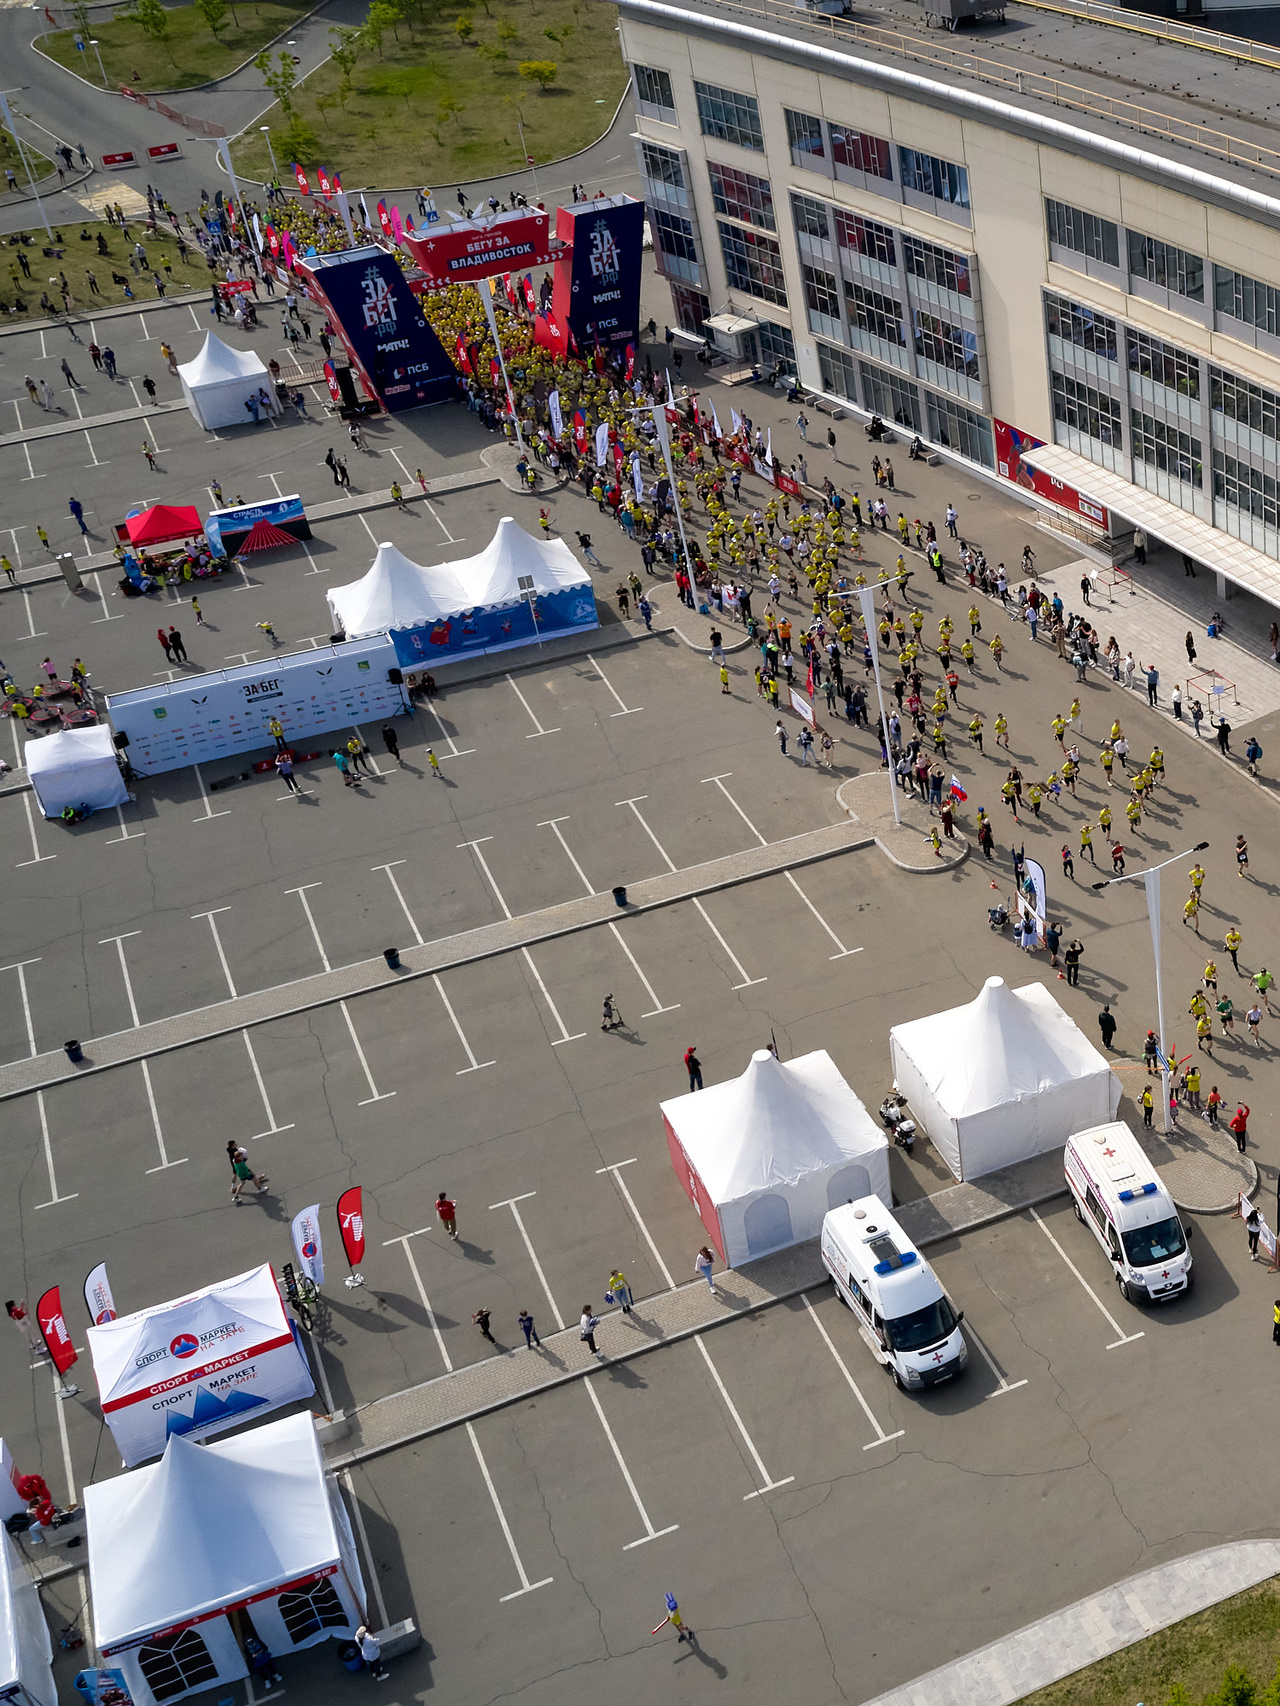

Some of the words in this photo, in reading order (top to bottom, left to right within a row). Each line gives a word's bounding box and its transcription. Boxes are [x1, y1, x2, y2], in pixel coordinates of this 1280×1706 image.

[466, 239, 493, 253] БЕГУ
[496, 236, 510, 246] ЗА
[590, 230, 616, 254] ЗА
[450, 243, 531, 270] ВЛАДИВОСТОК
[589, 249, 621, 276] БЕГ
[361, 277, 393, 304] ЗА
[593, 290, 621, 304] МАТЧ!
[362, 297, 397, 327] БЕГ
[598, 318, 618, 329] ПСБ
[377, 339, 410, 353] МАТЧ!
[407, 363, 429, 375] ПСБ
[233, 508, 263, 519] СТРАСТЬ
[243, 684, 260, 697] ЗА
[260, 679, 280, 693] БЕГ
[200, 1324, 237, 1343] МАРКЕТ
[200, 1341, 215, 1352] НА
[135, 1349, 168, 1367] СПОРТ
[149, 1374, 189, 1395] СПОРТ
[203, 1350, 249, 1374] МАРКЕТ
[208, 1365, 256, 1389] МАРКЕТ
[217, 1384, 231, 1392] НА
[233, 1373, 258, 1386] ЗАРЕ
[152, 1390, 193, 1411] СПОРТ
